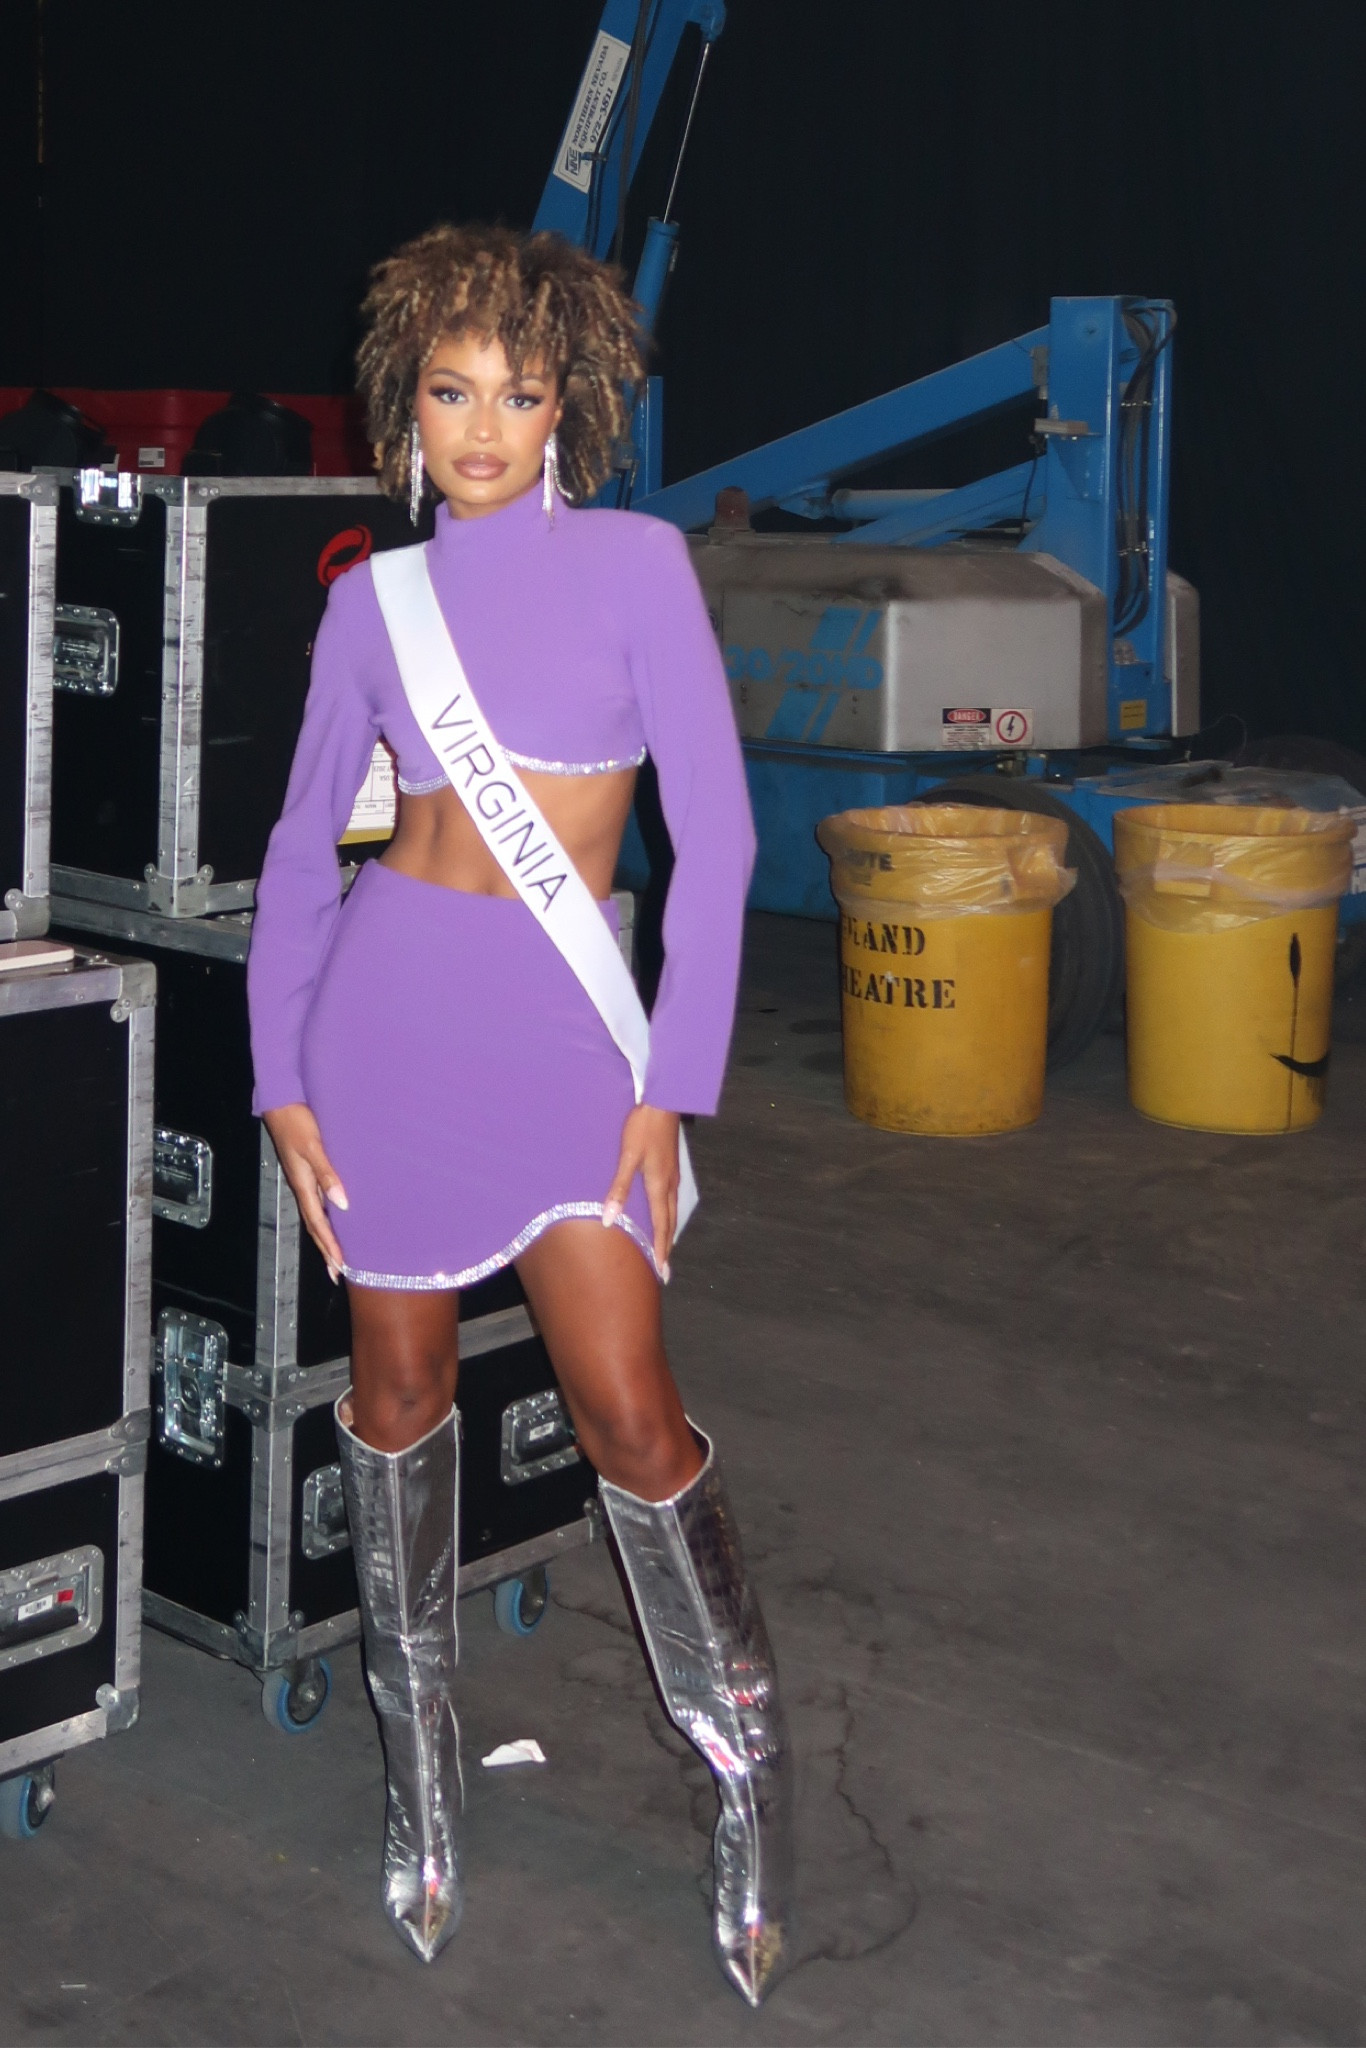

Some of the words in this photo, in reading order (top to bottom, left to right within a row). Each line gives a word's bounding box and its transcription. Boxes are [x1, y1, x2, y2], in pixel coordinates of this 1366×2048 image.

[572, 88, 593, 145] NORTHERN
[591, 45, 609, 87] NEVADA
[578, 88, 601, 149] EQUIPMENT
[599, 71, 609, 87] CO.
[431, 694, 567, 913] VIRGINIA
